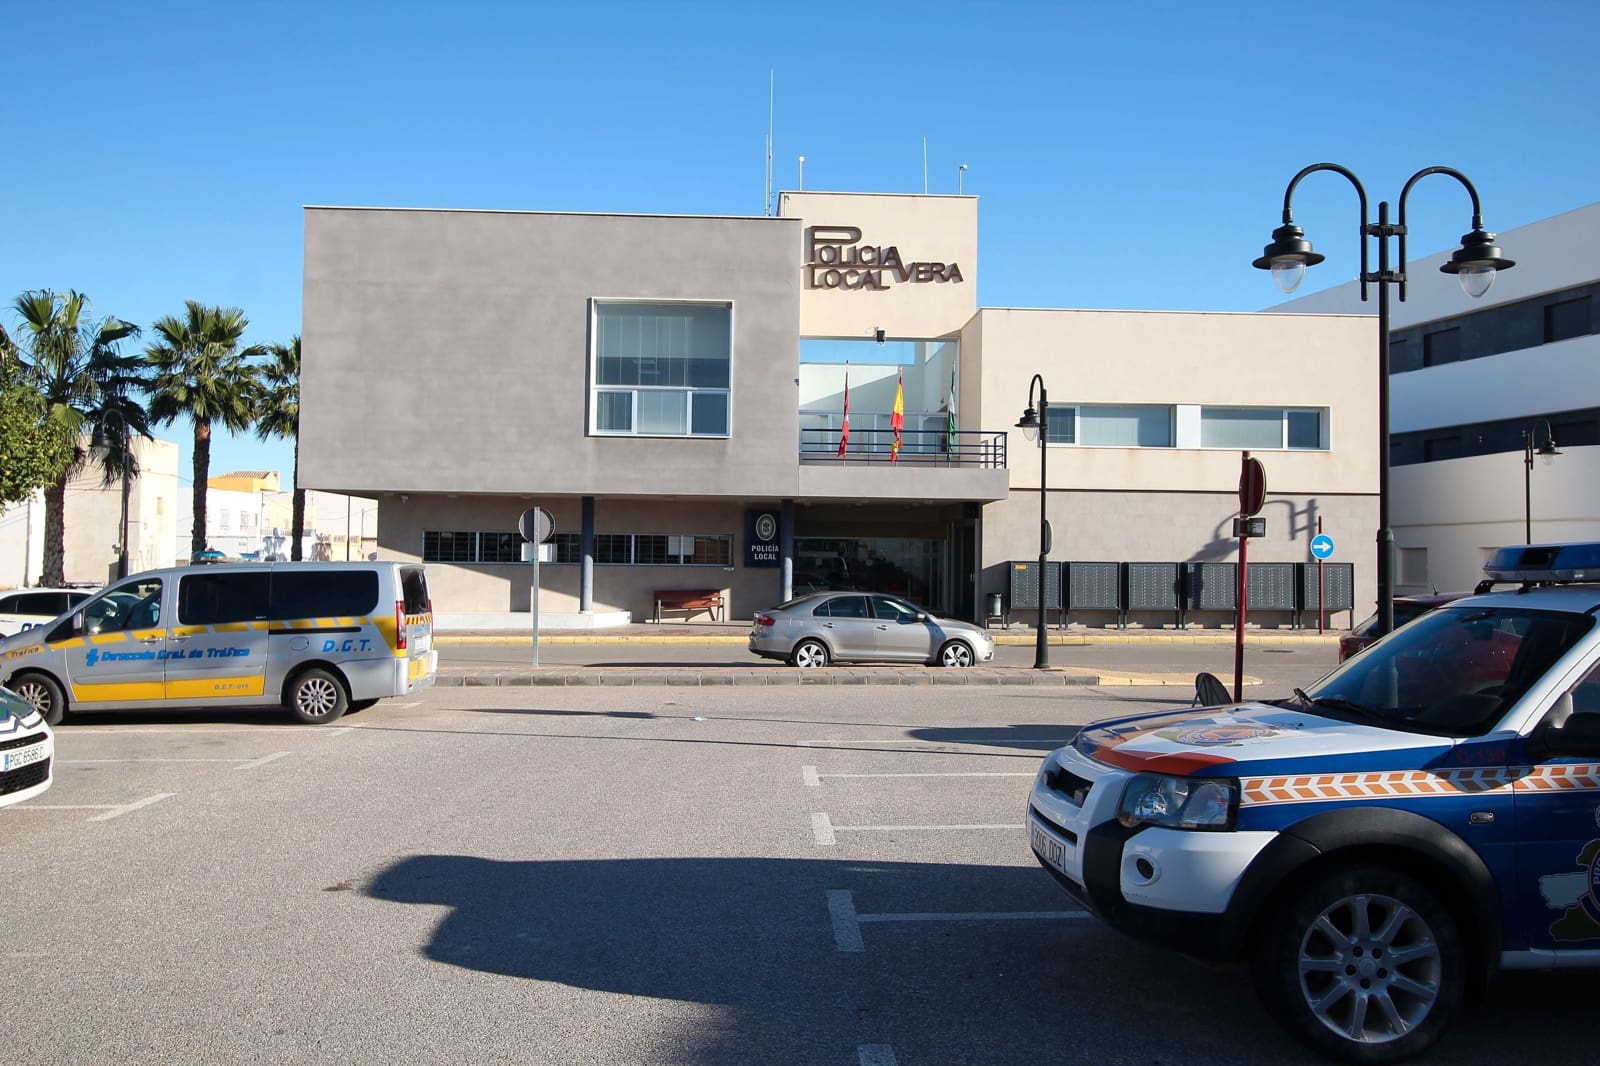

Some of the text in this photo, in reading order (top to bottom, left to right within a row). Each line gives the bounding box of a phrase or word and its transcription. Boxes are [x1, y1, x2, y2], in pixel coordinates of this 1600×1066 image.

[810, 225, 900, 266] POLICIA
[809, 254, 964, 290] LOCAL VERA
[754, 552, 776, 560] LOCAL
[322, 639, 371, 652] D.G.T.
[187, 648, 204, 659] de
